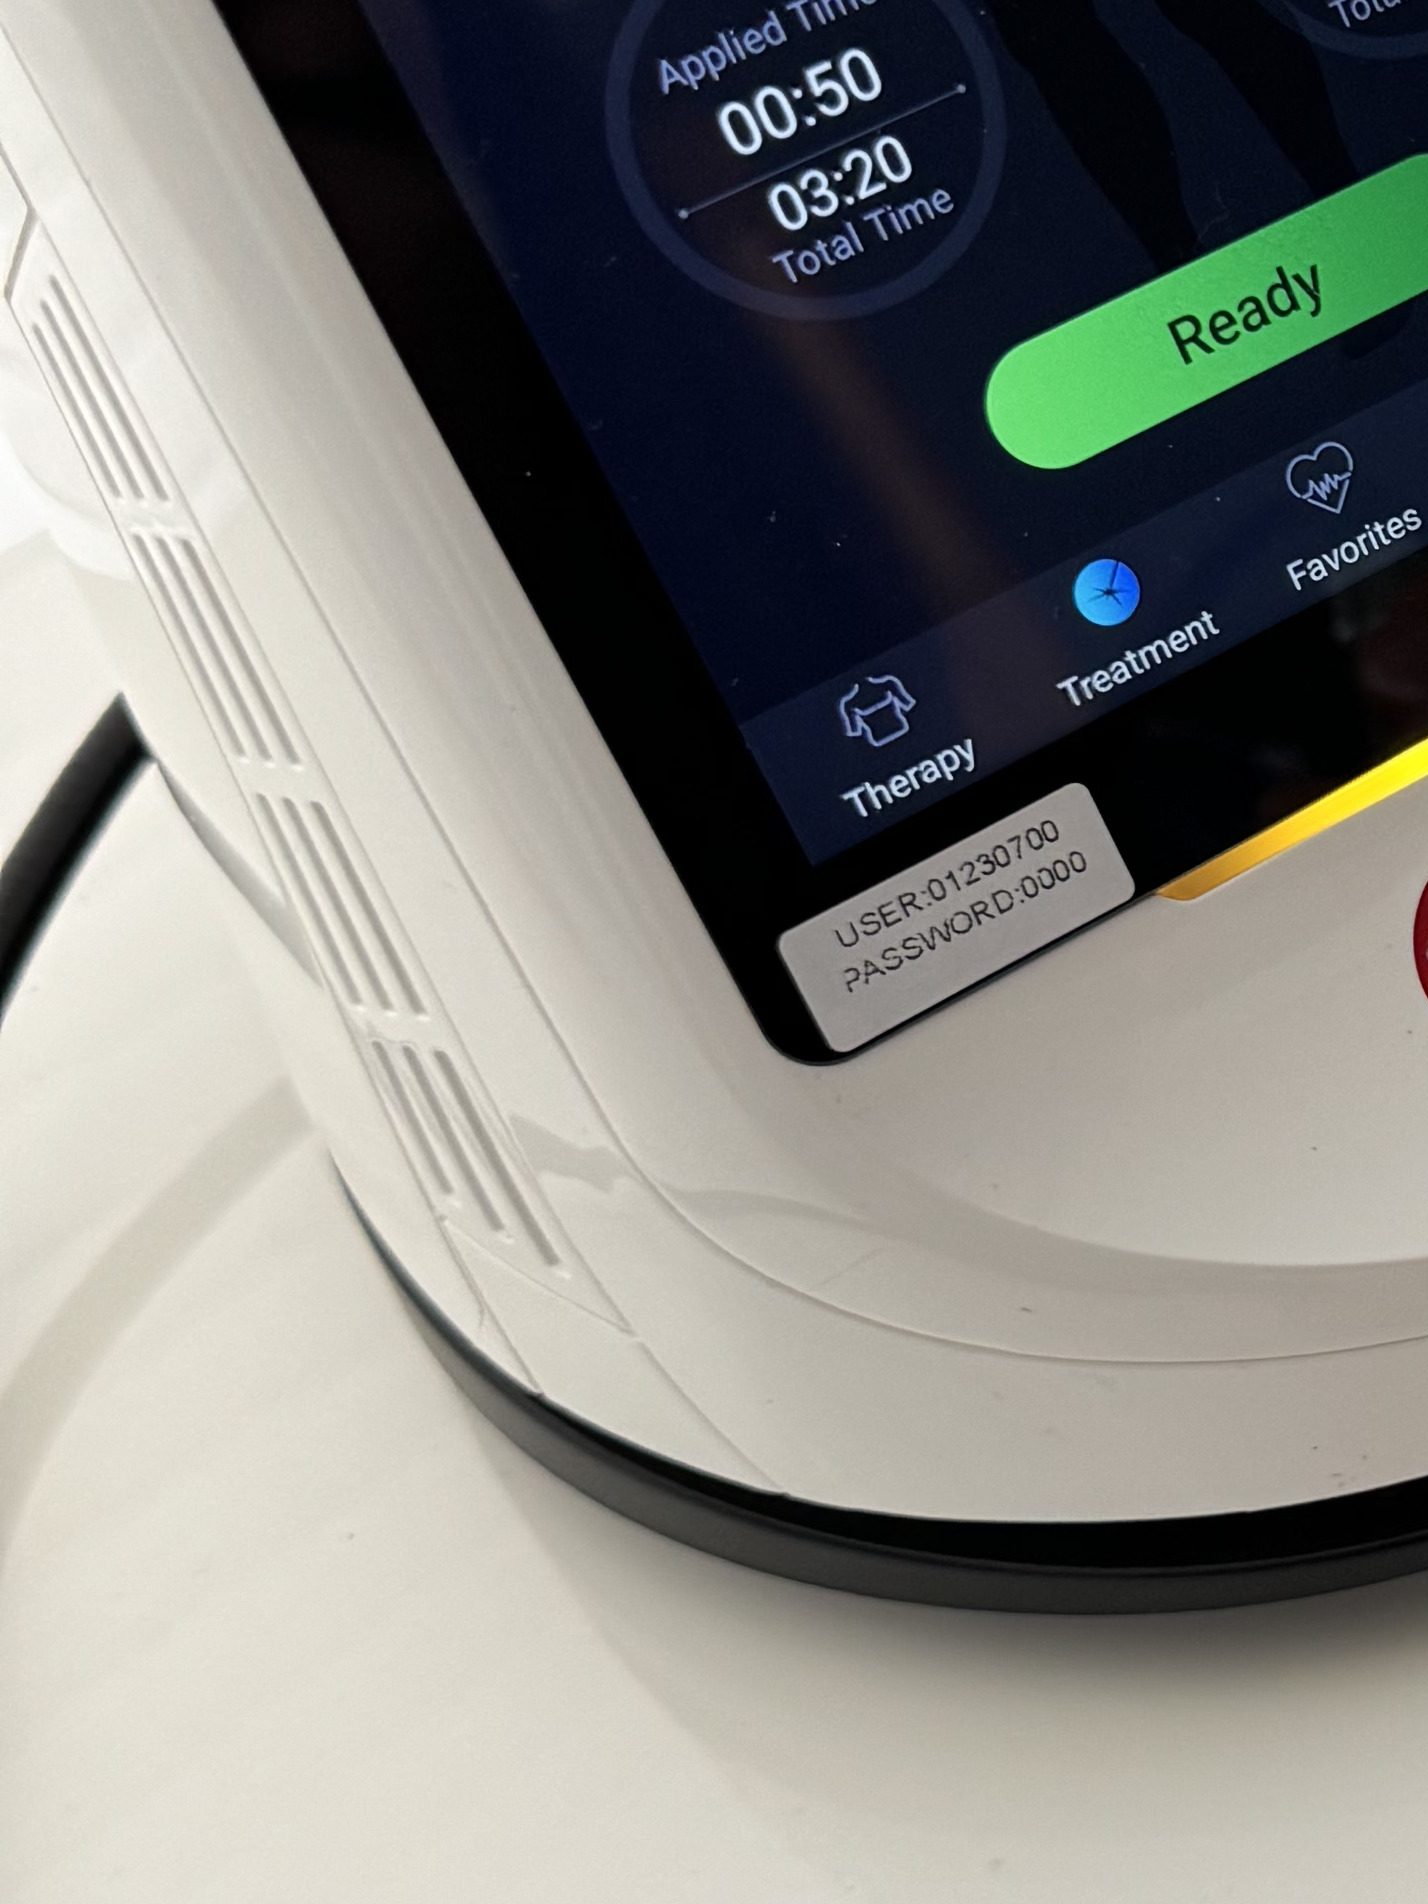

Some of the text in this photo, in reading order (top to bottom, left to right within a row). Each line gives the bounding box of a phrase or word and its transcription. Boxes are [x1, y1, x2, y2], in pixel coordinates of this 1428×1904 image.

[657, 10, 787, 95] Applied
[717, 47, 883, 156] 00:50
[767, 134, 913, 232] 03:20
[772, 187, 955, 284] Total Time
[1167, 262, 1325, 365] Ready
[1285, 503, 1423, 592] Favorites
[1055, 610, 1220, 707] Treatment
[841, 738, 977, 818] Therapy
[834, 819, 1060, 949] USER:01230700
[842, 850, 1088, 993] PASSWORD:0000
